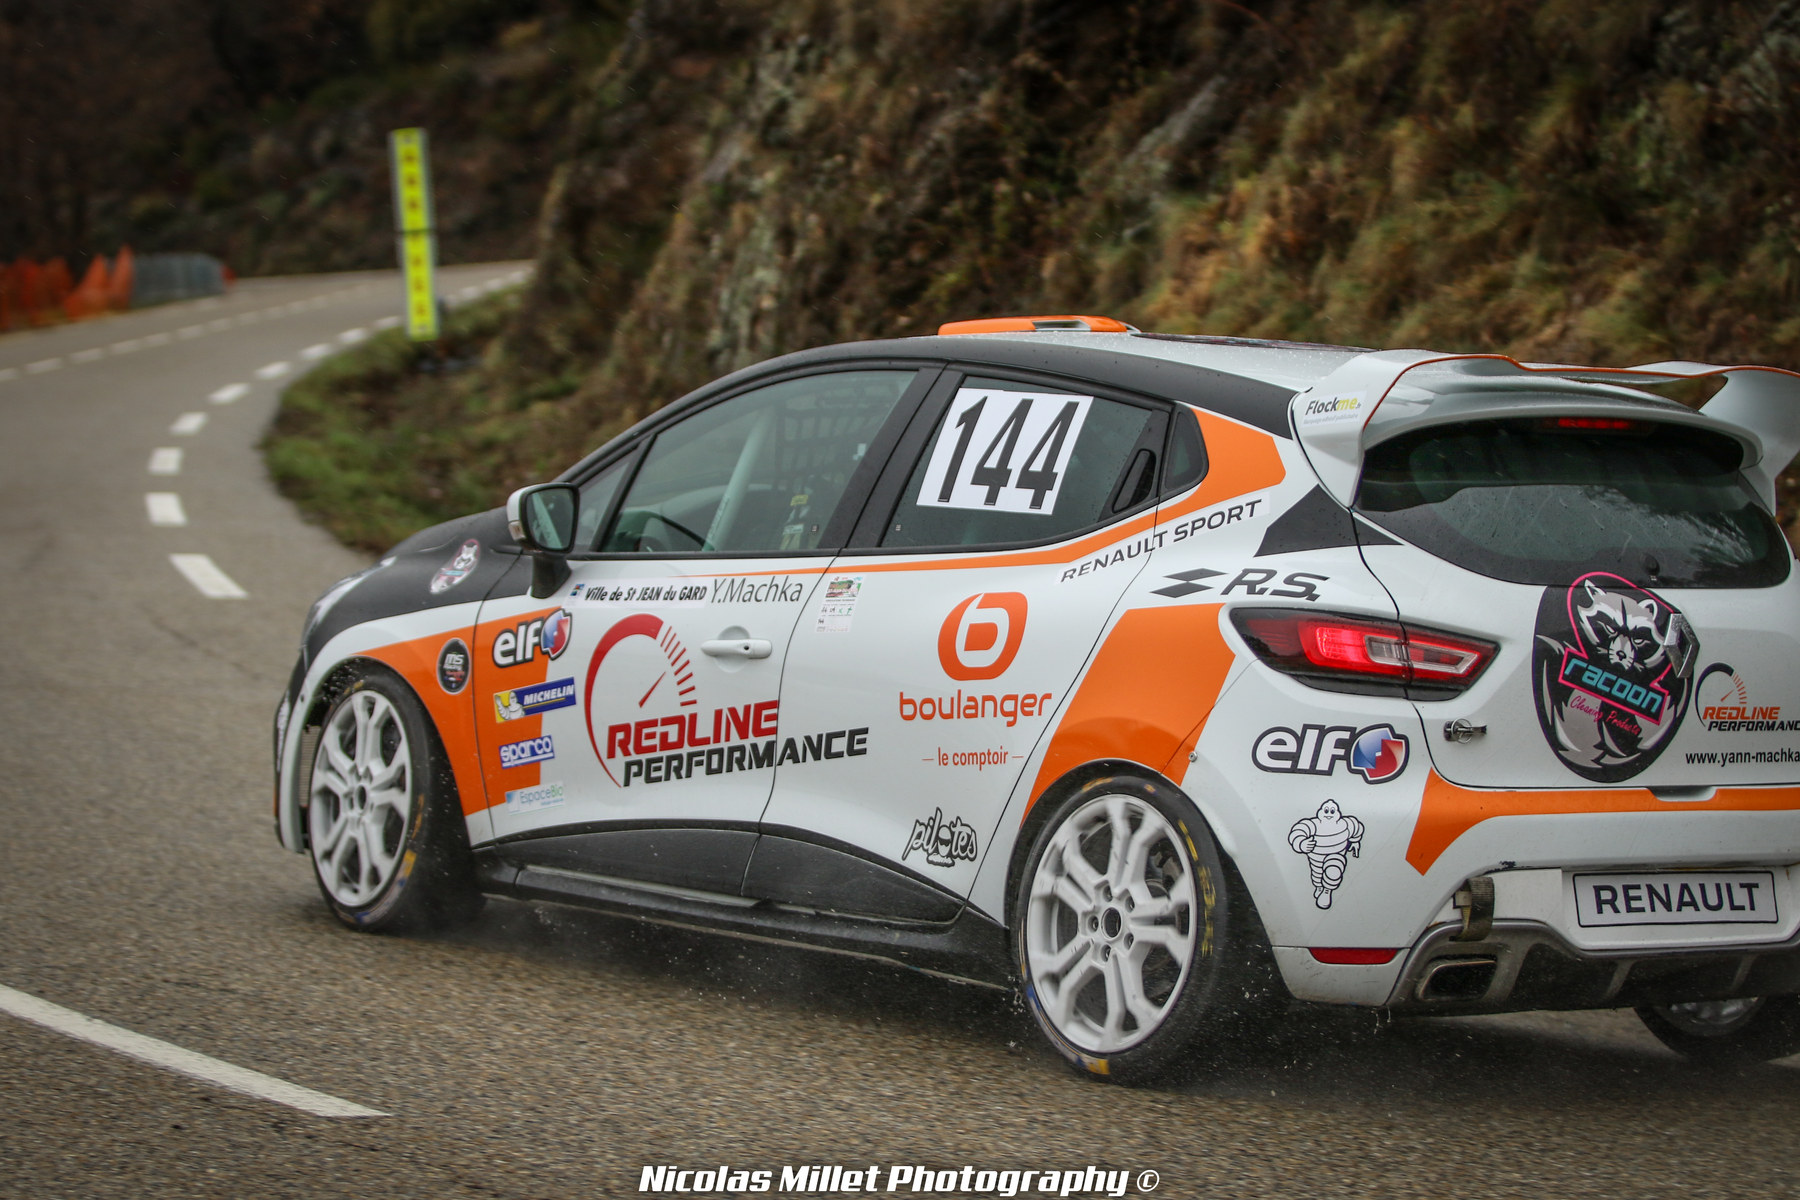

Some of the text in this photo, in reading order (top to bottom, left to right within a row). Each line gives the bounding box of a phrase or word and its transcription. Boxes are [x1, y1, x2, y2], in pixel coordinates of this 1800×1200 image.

[937, 395, 1081, 510] 144
[1060, 499, 1262, 583] RENAULT SPORT
[585, 584, 708, 602] Ville de St JEAN du GARD
[710, 575, 804, 603] Y.Machka
[493, 618, 543, 667] elf
[523, 685, 575, 705] MICHELIN
[1564, 658, 1663, 713] racoon
[899, 689, 1052, 727] boulanger
[1570, 695, 1641, 735] Cleaning Products
[1702, 706, 1781, 720] REDLINE
[607, 700, 779, 759] REDLINE
[500, 736, 552, 764] sparco
[623, 727, 869, 787] PERFORMANCE
[938, 745, 1009, 771] le comptoir
[1253, 725, 1354, 774] elf
[519, 784, 563, 805] EspaceBio
[1593, 883, 1759, 914] RENAULT
